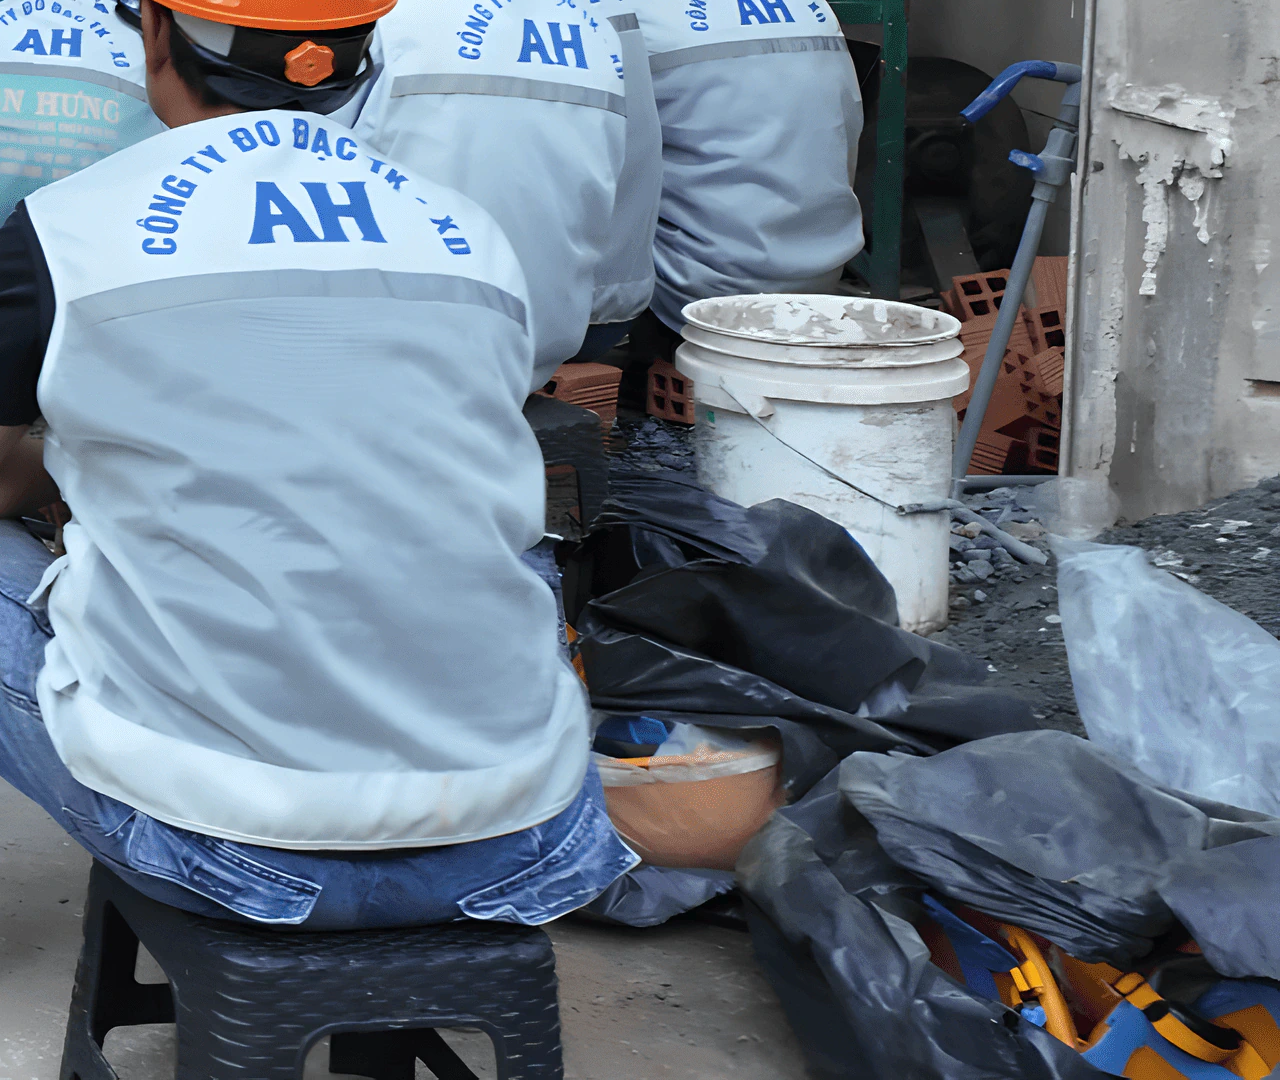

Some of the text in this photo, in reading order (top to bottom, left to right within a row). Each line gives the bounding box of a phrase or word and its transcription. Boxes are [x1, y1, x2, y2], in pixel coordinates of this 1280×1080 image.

[13, 28, 83, 57] AH
[457, 4, 493, 59] CÔNG
[517, 19, 588, 69] AH
[34, 89, 120, 124] HƯNG
[136, 175, 197, 254] CÔNG
[181, 145, 226, 173] TY
[228, 120, 280, 152] ĐO
[293, 115, 360, 160] ĐẠC
[366, 156, 409, 193] TK
[430, 216, 471, 255] XD
[248, 182, 387, 244] AH
